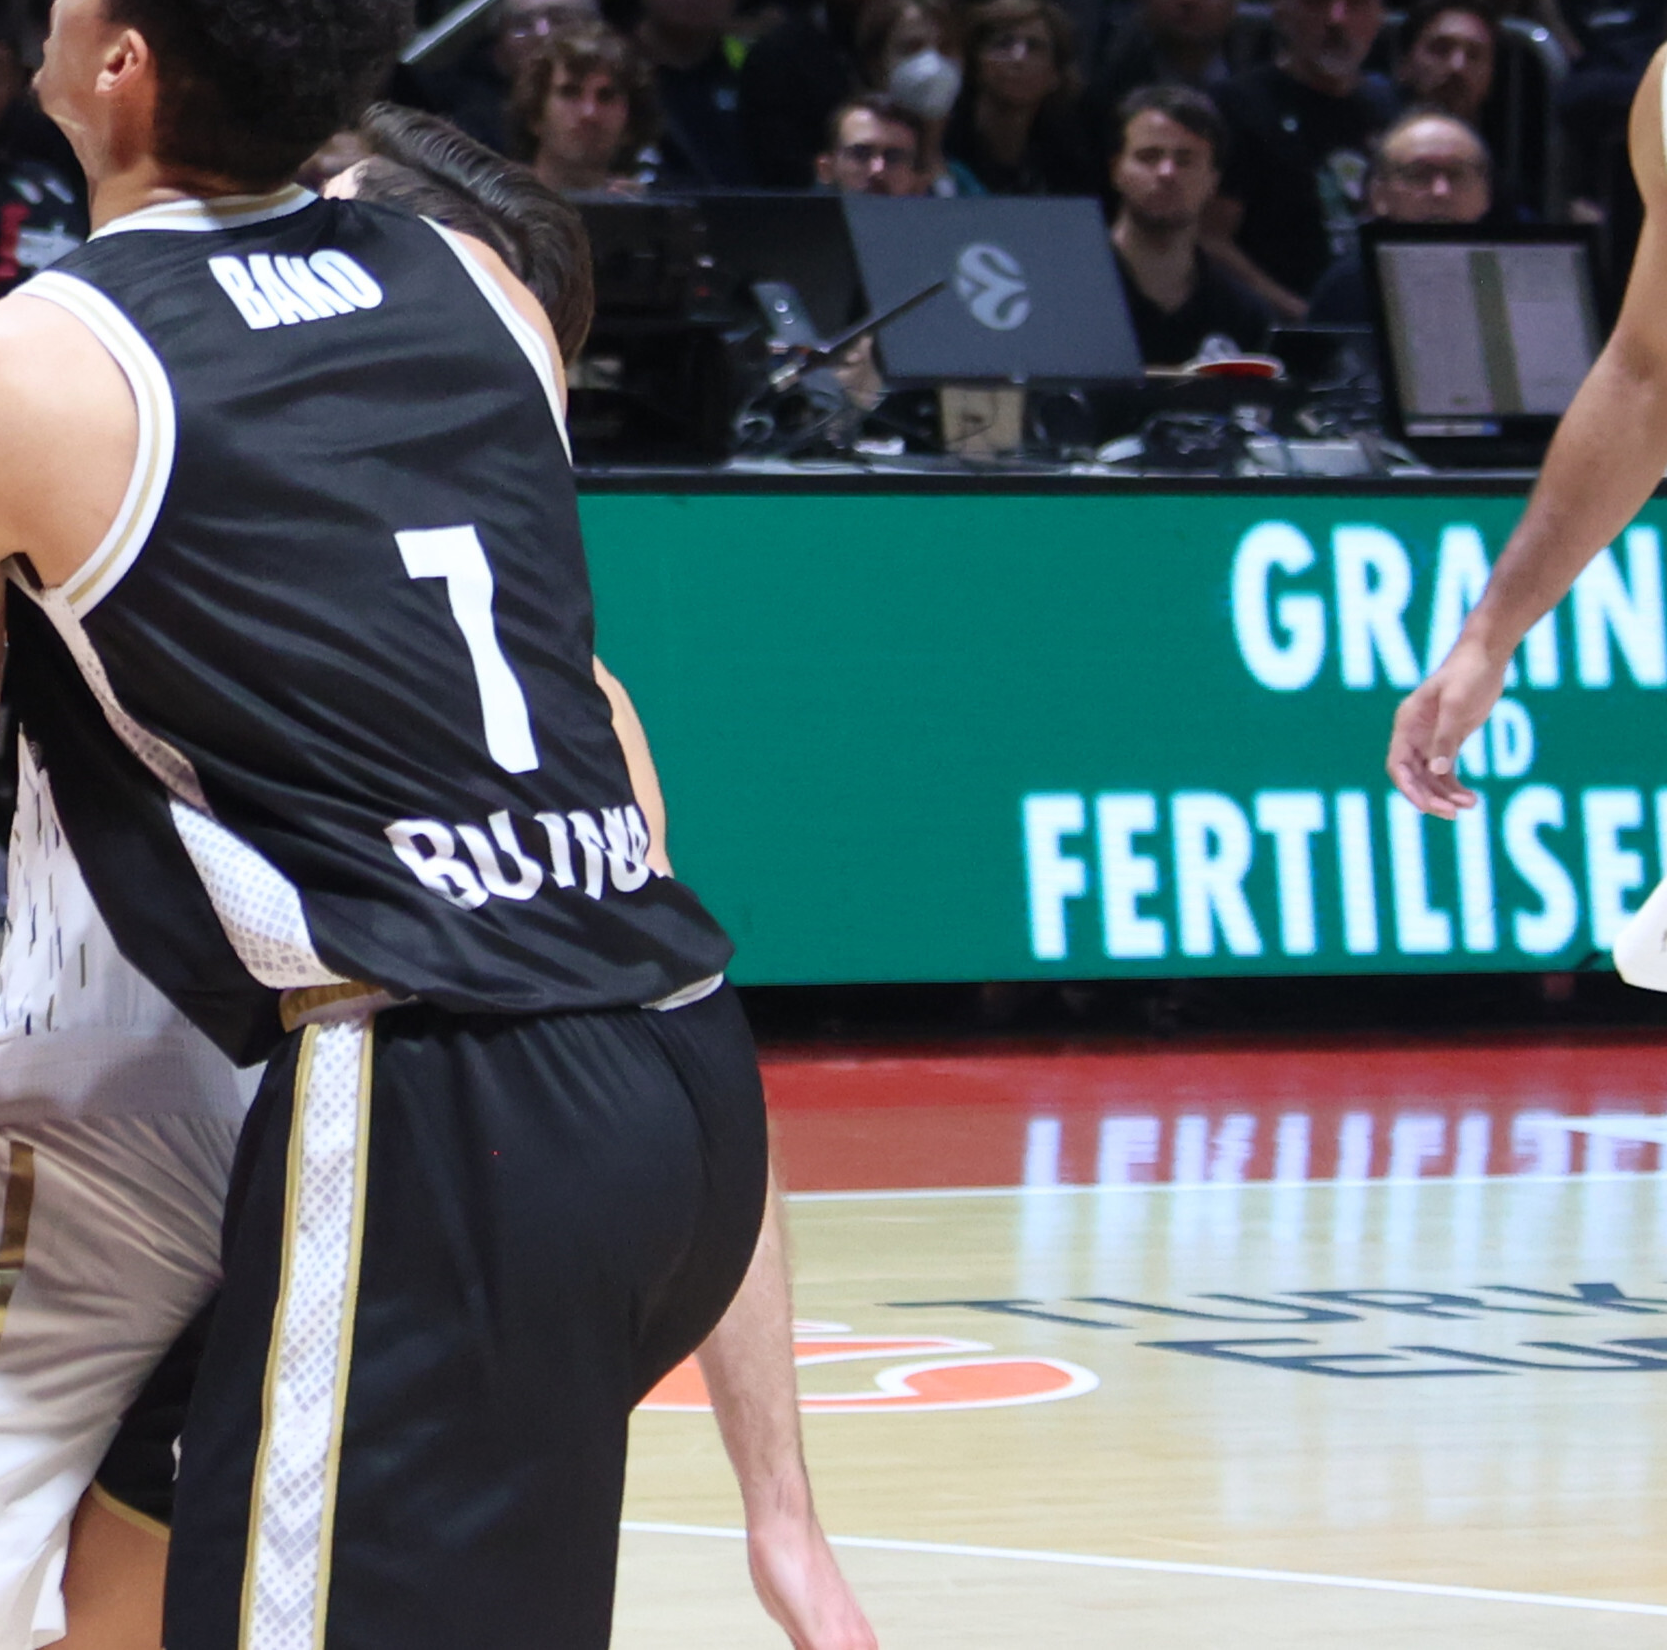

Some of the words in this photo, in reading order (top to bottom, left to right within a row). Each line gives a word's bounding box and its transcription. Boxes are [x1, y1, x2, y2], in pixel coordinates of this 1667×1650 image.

[208, 248, 384, 330] BAKO
[394, 523, 540, 774] 7
[1022, 784, 1667, 960] FERTILISE
